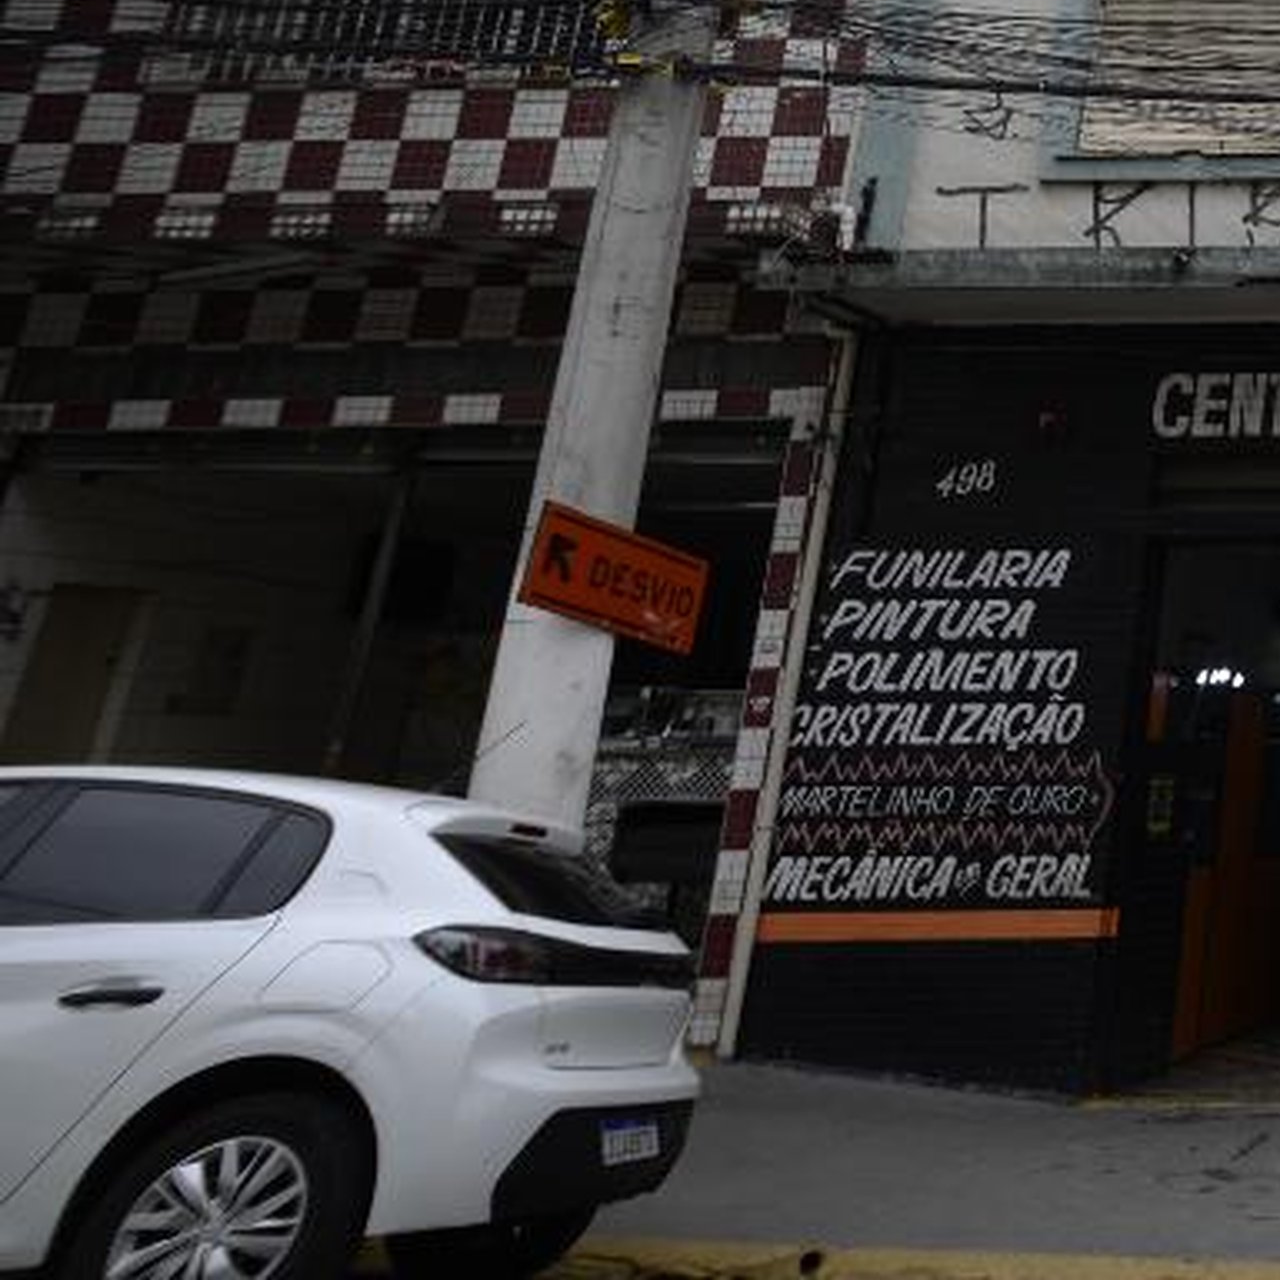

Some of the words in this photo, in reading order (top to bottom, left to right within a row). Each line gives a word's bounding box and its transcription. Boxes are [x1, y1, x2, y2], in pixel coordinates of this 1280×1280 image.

[934, 459, 999, 498] 498
[588, 554, 695, 617] DESVIO
[829, 548, 1073, 590] FUNILARIA
[822, 599, 1038, 641] PINTURA
[815, 647, 1081, 694] POLIMENTO
[790, 690, 1087, 751] CRISTALIZAÇÃO
[777, 784, 957, 818] MARTELINHO
[963, 784, 1006, 819] DE
[1008, 784, 1089, 817] OURO
[765, 849, 959, 902] MECÂNICA
[985, 853, 1094, 900] GERAL
